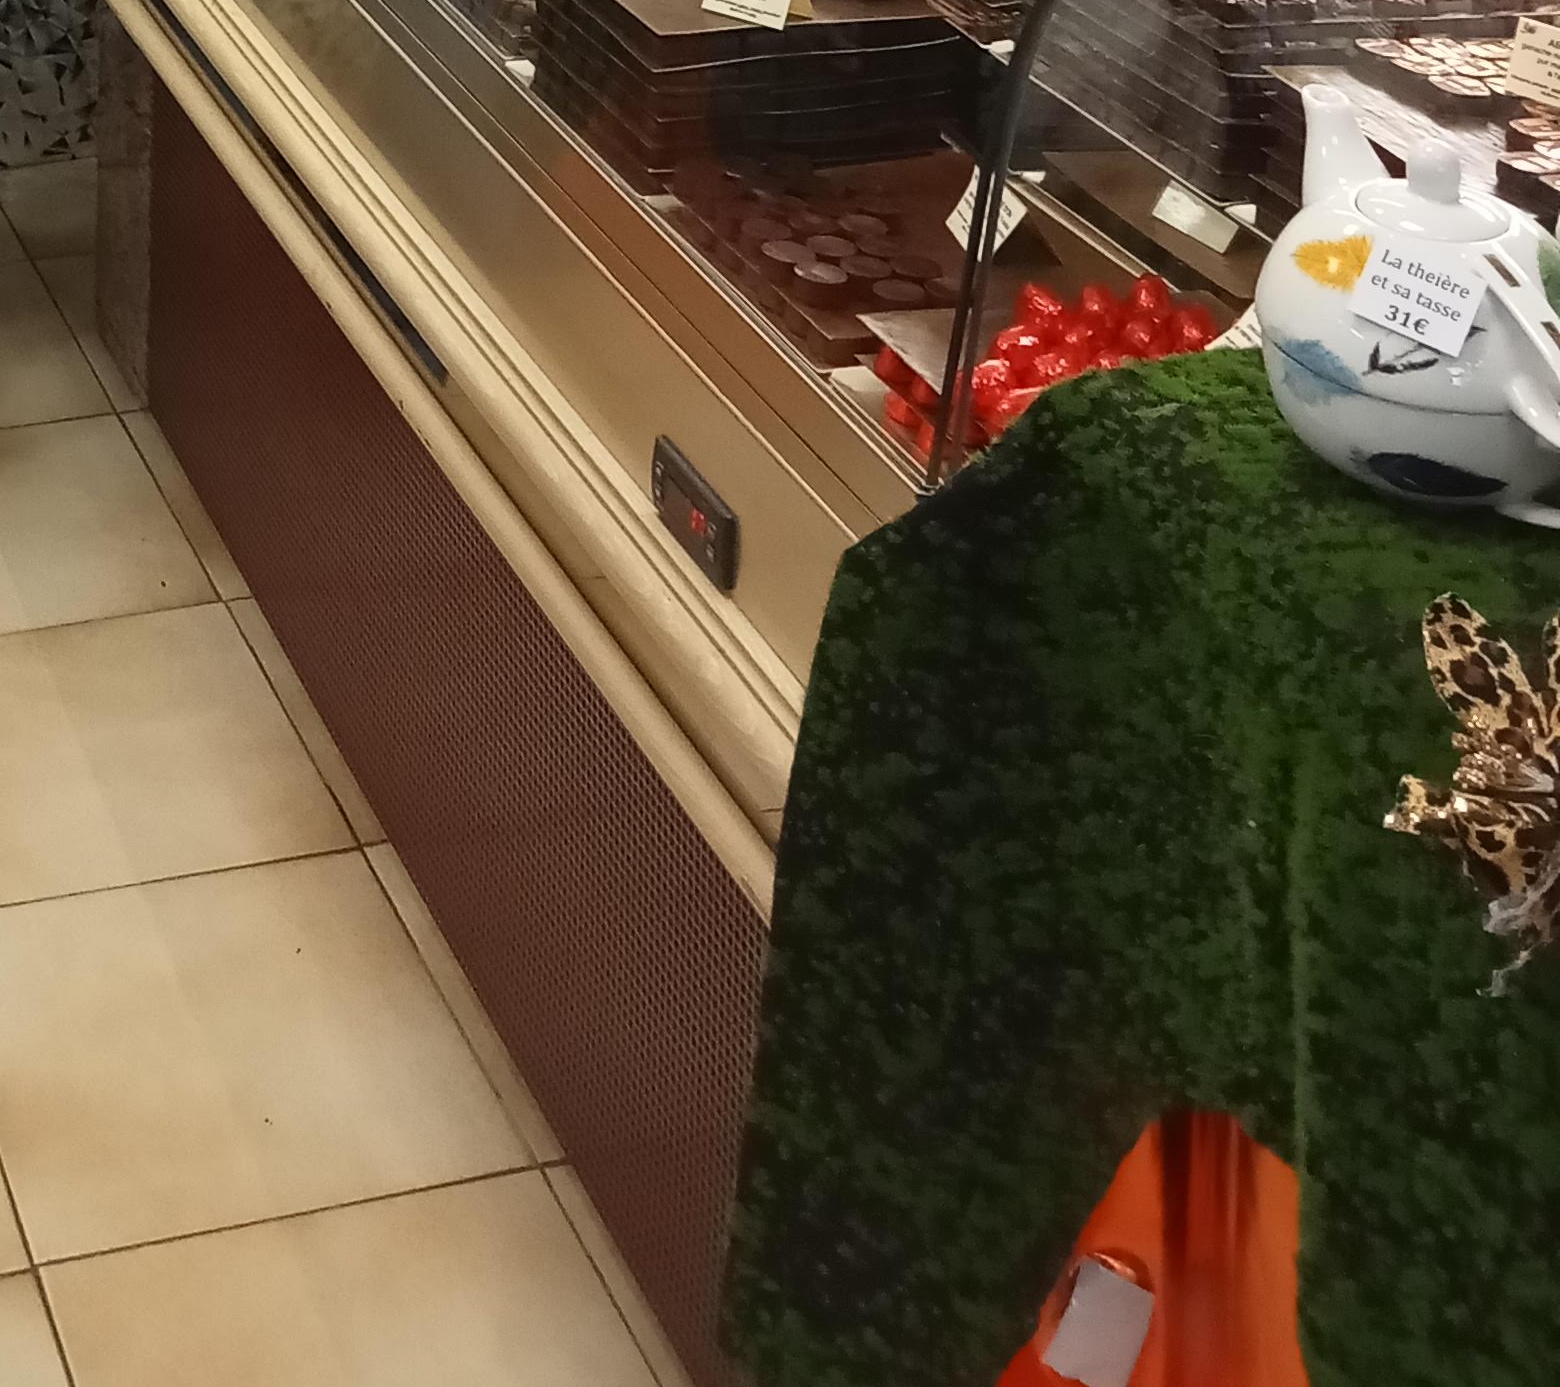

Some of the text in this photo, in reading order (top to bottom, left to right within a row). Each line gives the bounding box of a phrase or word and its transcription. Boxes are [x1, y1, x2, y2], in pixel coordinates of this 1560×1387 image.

[1381, 249, 1402, 269] La
[1370, 273, 1462, 322] et sa tasse
[1384, 304, 1429, 336] 31€
